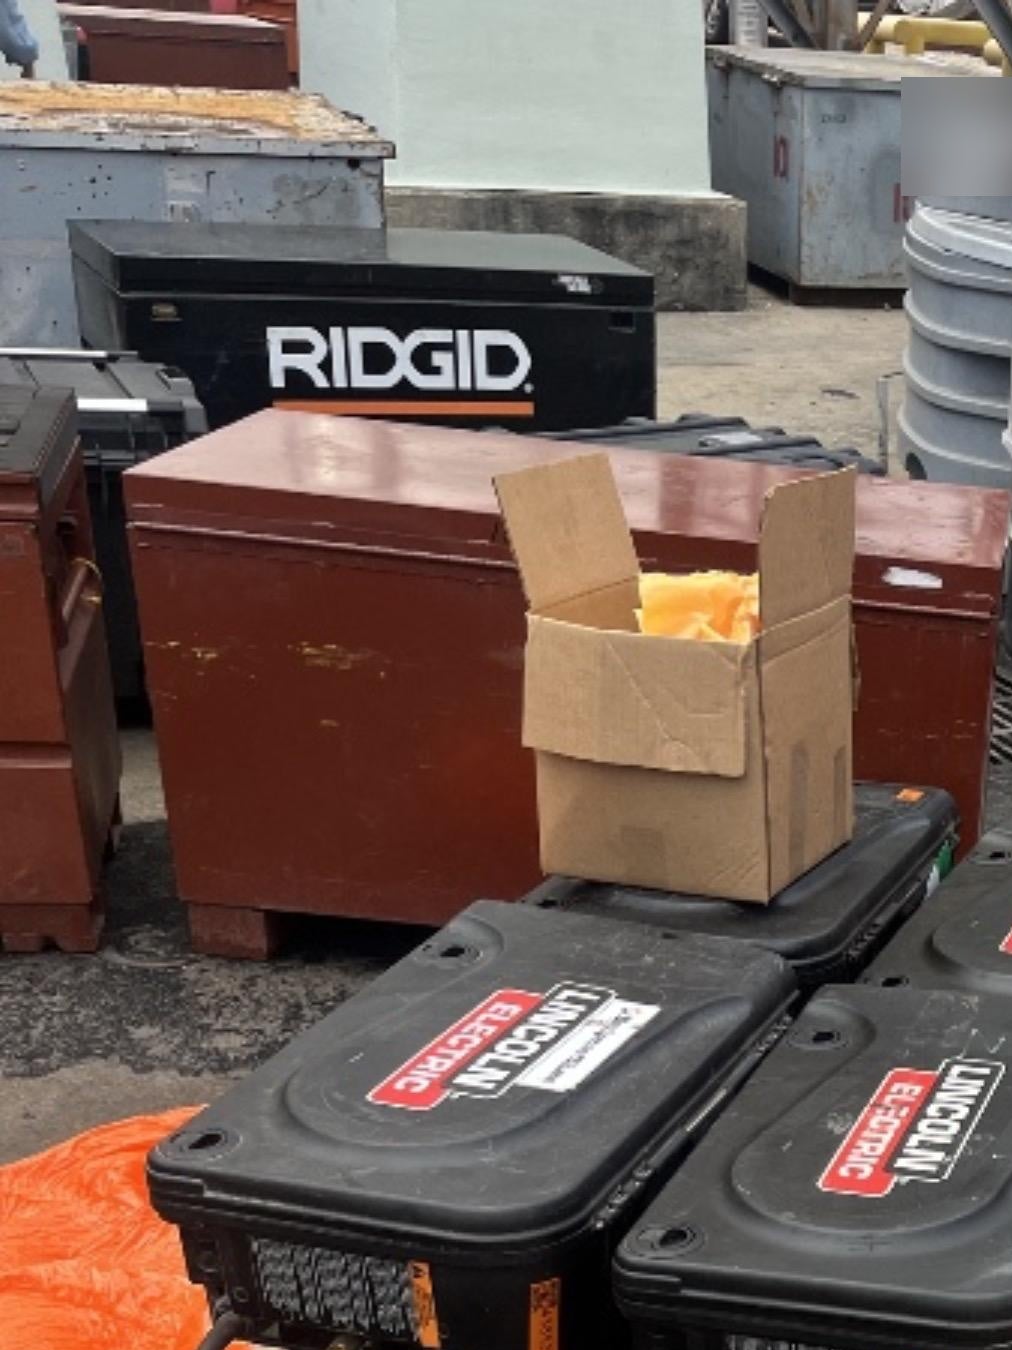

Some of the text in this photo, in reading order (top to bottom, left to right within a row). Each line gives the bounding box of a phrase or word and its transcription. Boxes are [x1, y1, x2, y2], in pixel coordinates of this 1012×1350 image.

[266, 326, 533, 391] RIDGID
[394, 1002, 523, 1094] ELECTRIC
[452, 989, 601, 1090] LINCOLN
[837, 1082, 924, 1180] ELECTRIC
[894, 1064, 991, 1172] LINCOLN
